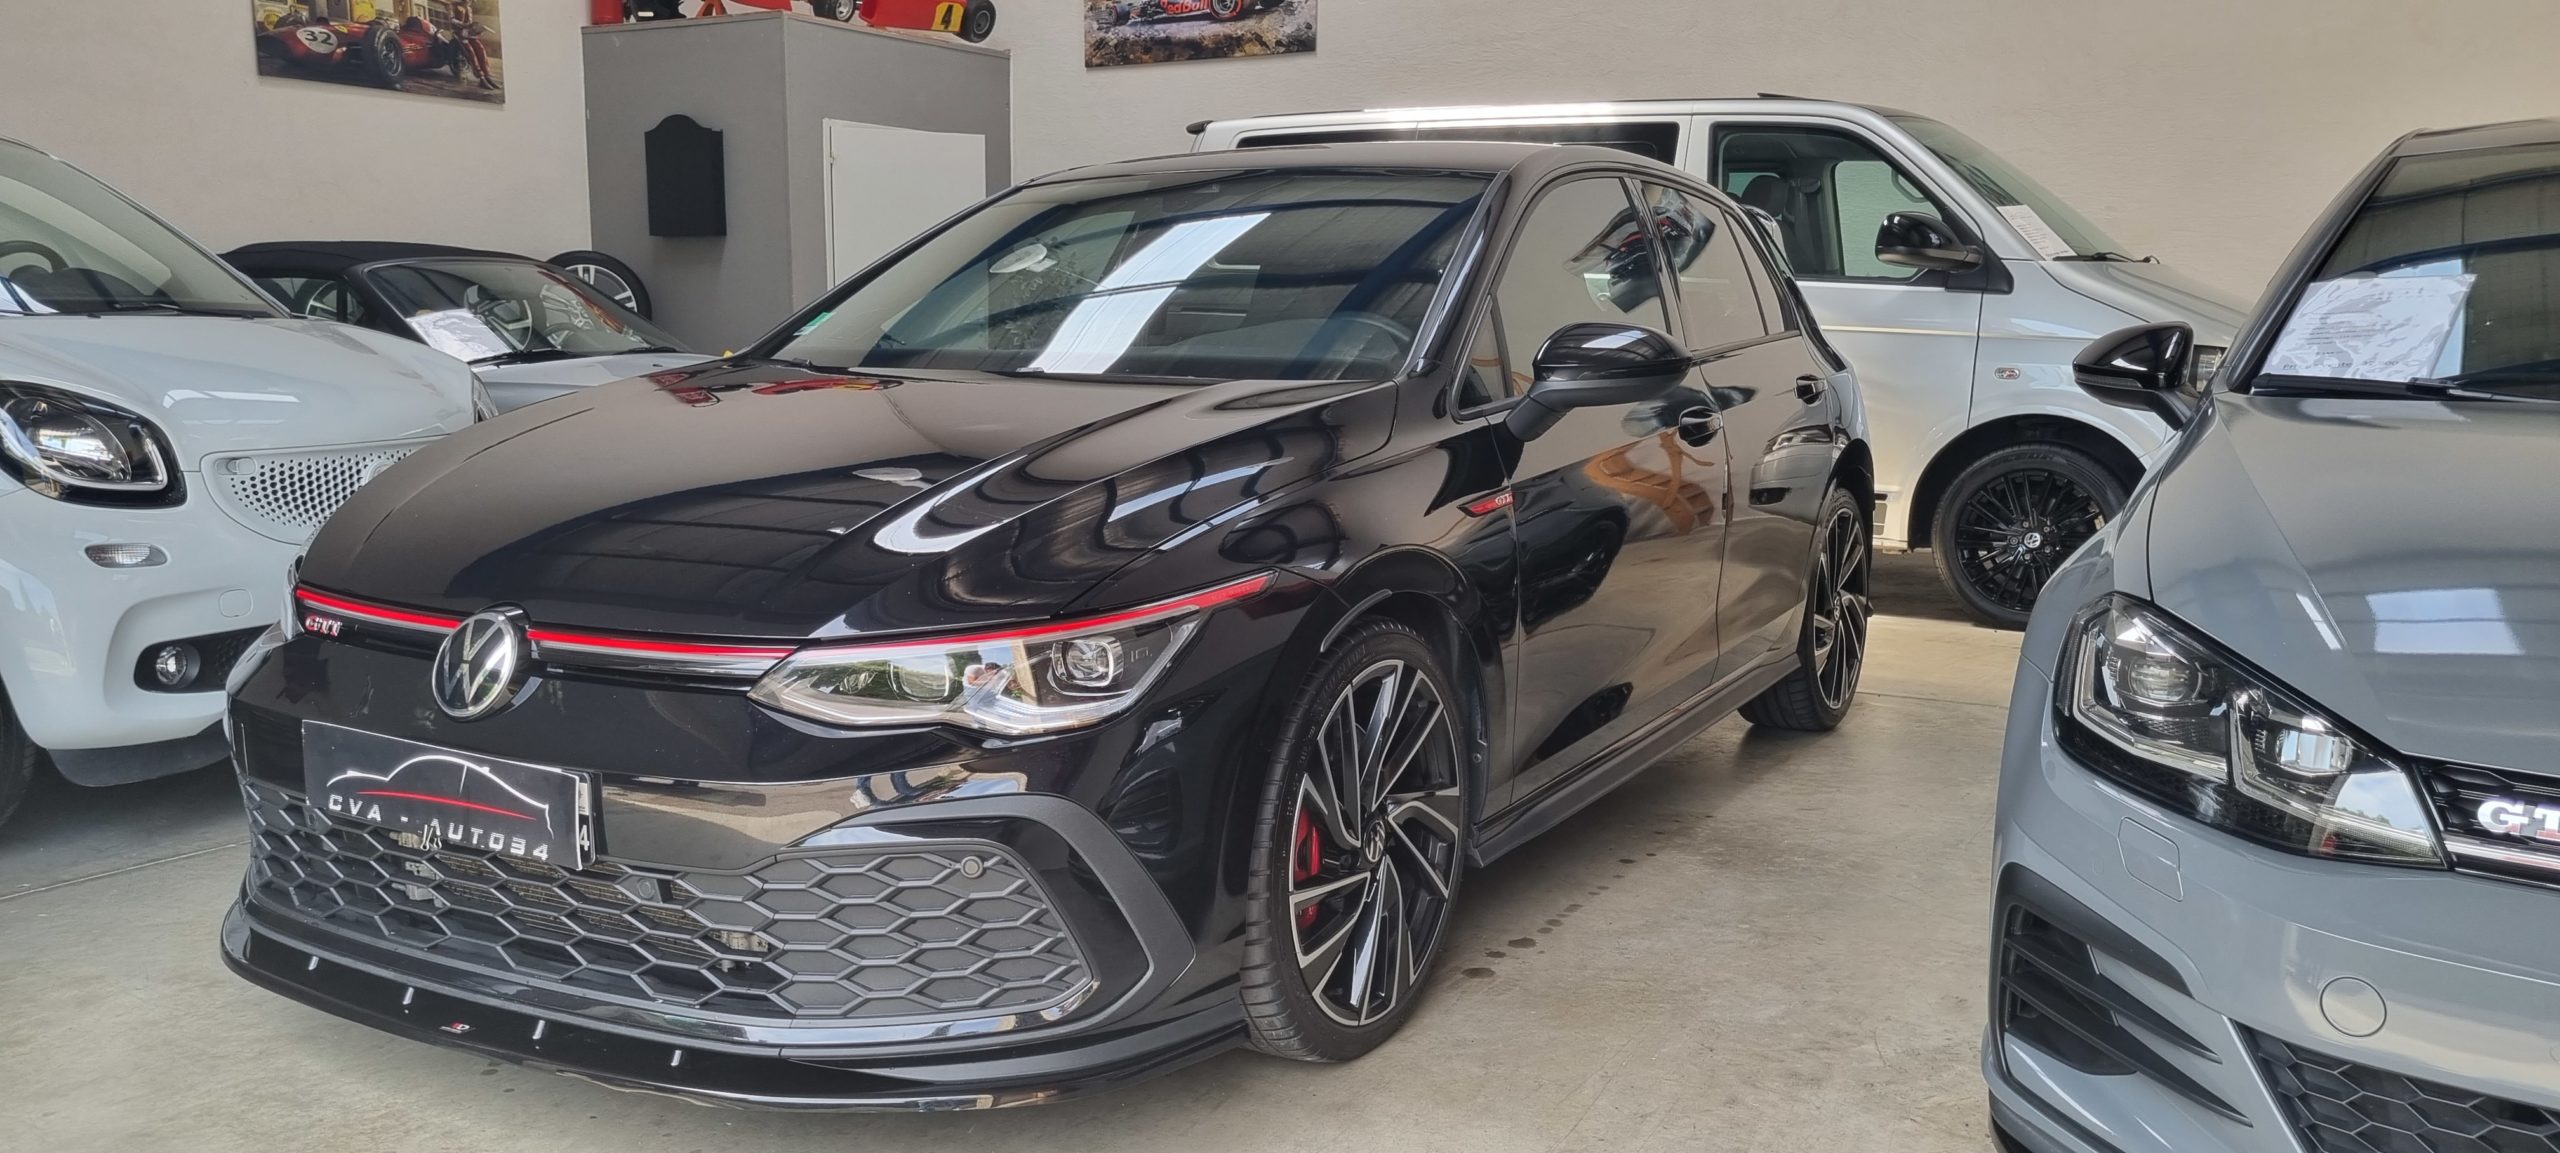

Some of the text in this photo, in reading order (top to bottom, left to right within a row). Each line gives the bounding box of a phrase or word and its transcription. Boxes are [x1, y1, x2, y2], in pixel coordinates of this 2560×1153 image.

[940, 4, 955, 30] 4
[303, 30, 334, 46] 32
[305, 614, 343, 637] GTI
[328, 794, 381, 822] CVA
